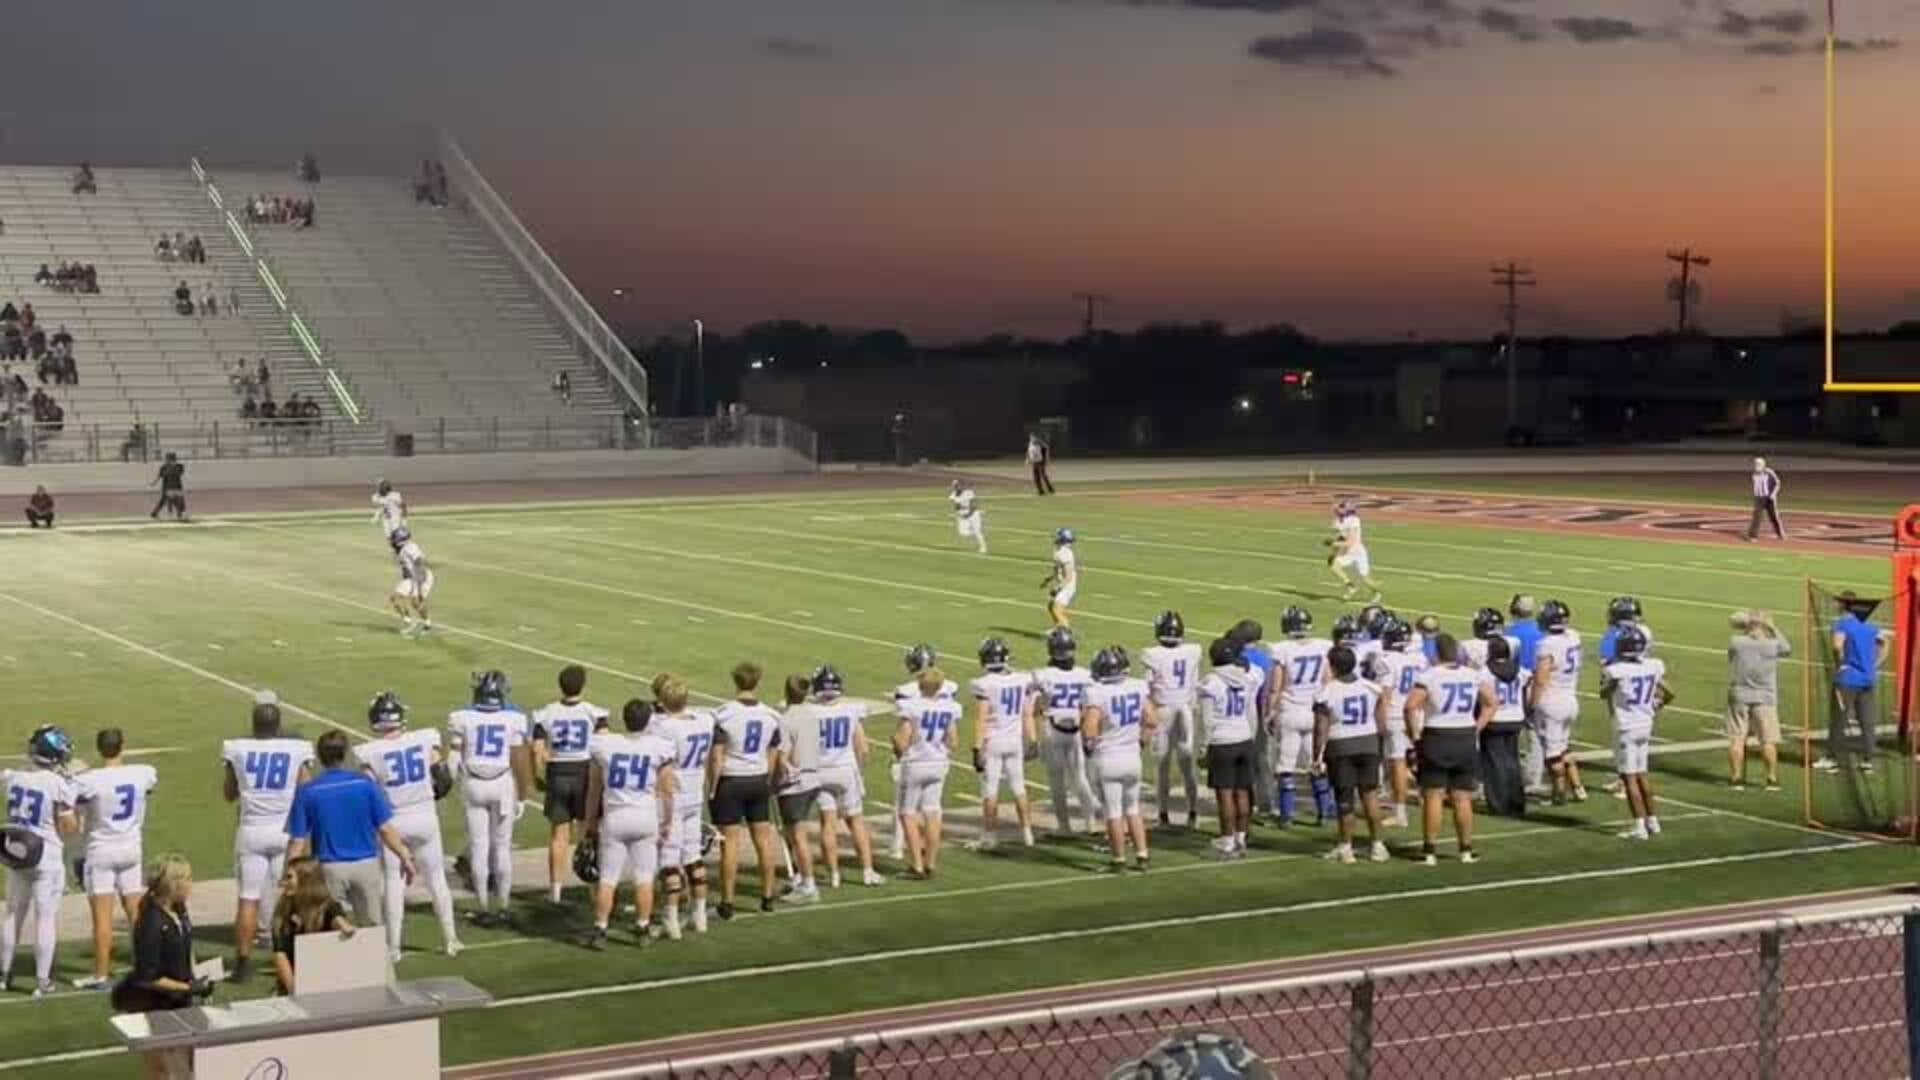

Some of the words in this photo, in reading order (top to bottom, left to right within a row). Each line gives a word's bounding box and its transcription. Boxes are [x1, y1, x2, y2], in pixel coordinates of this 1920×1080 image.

[1173, 659, 1186, 688] 4
[1293, 655, 1322, 684] 77
[1000, 686, 1022, 715] 41
[1051, 684, 1082, 708] 22
[1440, 682, 1473, 714] 75
[1626, 674, 1656, 705] 37
[1111, 692, 1141, 727] 42
[1342, 694, 1369, 725] 51
[475, 724, 505, 757] 15
[743, 720, 763, 753] 8
[246, 751, 291, 790] 48
[384, 746, 426, 786] 36
[608, 753, 650, 789] 64
[112, 784, 136, 821] 3
